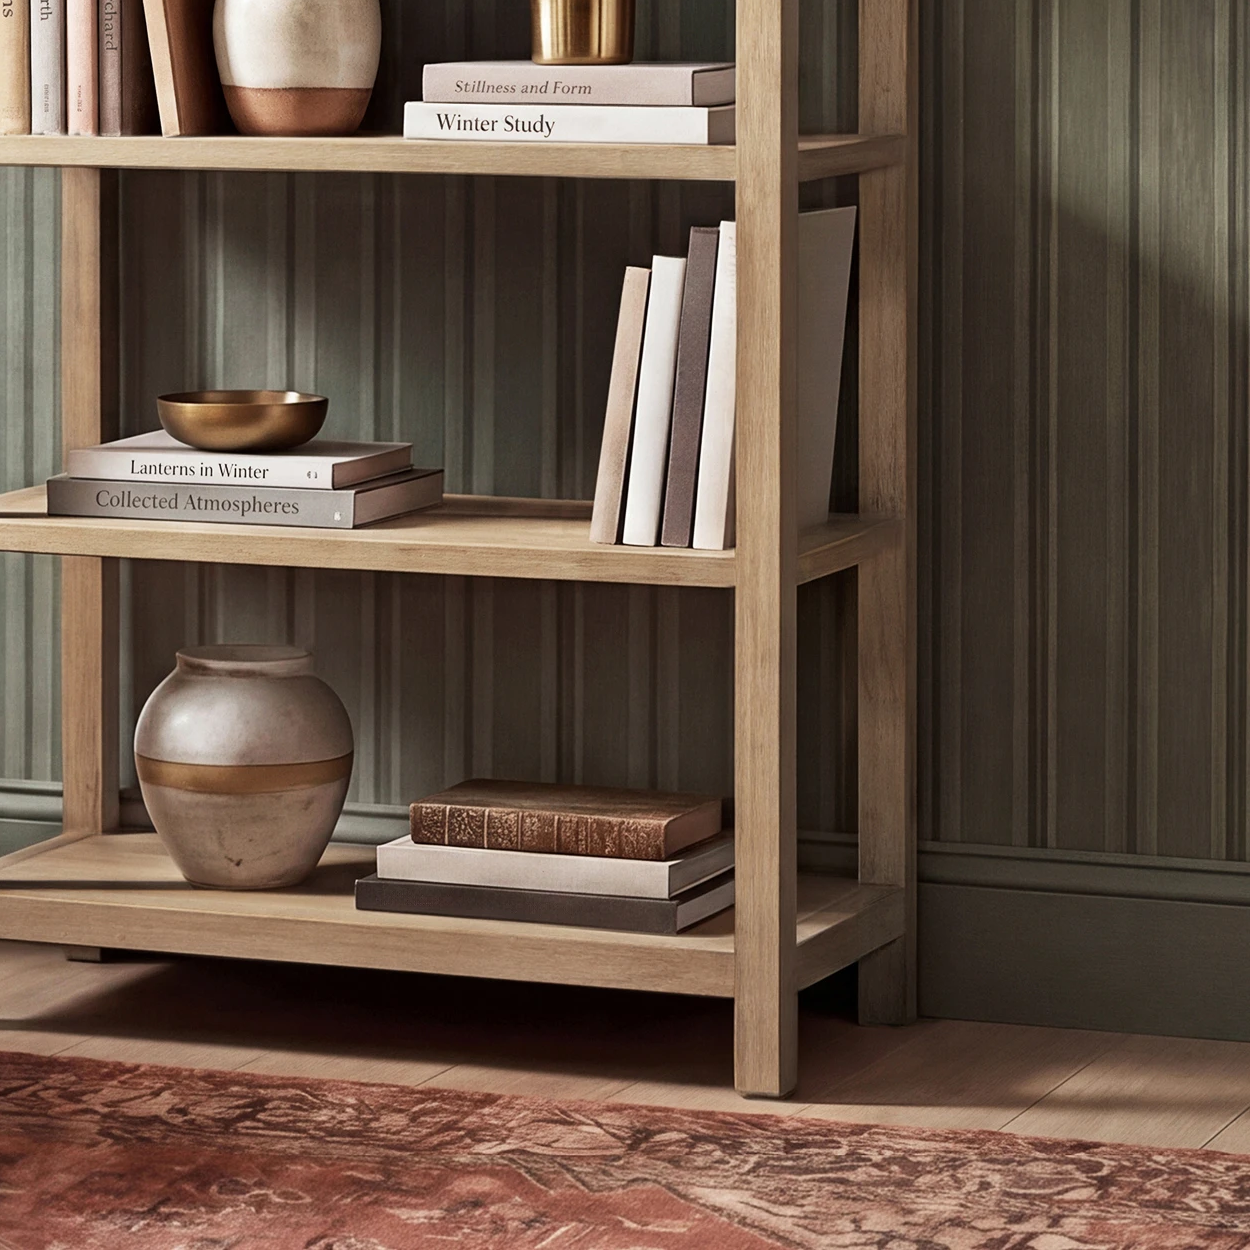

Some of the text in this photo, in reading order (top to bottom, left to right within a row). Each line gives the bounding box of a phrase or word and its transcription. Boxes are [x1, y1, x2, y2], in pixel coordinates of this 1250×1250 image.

[454, 79, 592, 95] Stillness and Form
[436, 113, 555, 137] Winter Study
[130, 459, 270, 480] Lanterns in Winter
[95, 489, 300, 517] Collected Atmospheres
